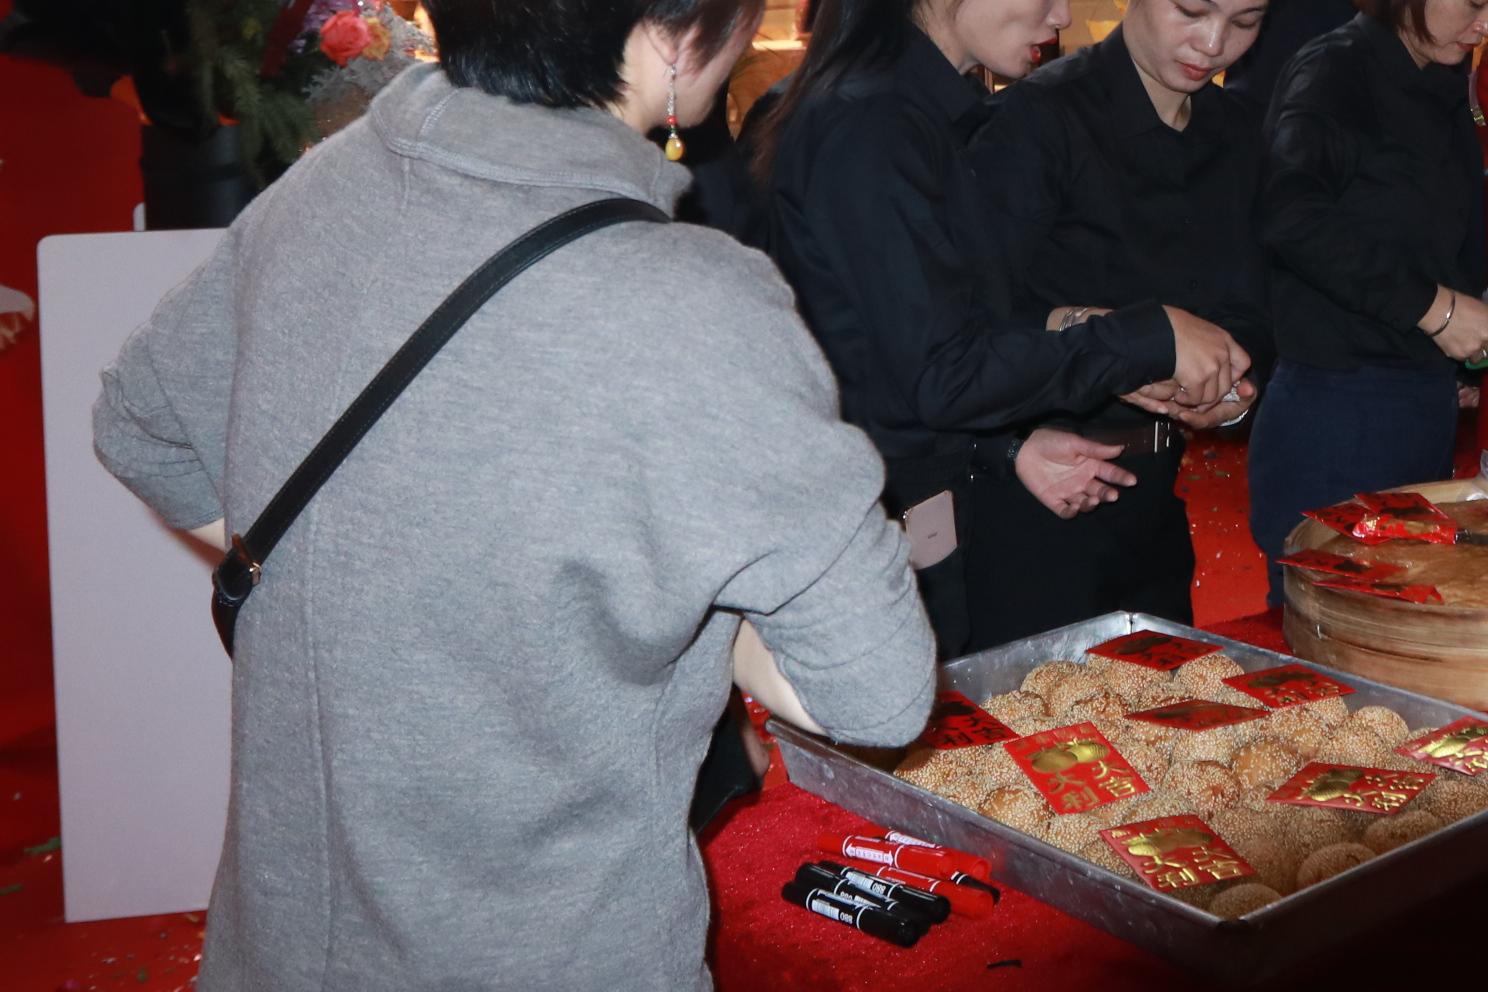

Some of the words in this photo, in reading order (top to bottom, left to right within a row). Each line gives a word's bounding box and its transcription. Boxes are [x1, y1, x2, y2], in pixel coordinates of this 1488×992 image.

[1046, 771, 1100, 810] 大利
[1091, 759, 1137, 799] 大吉
[1143, 855, 1200, 889] 大利
[1192, 845, 1243, 881] 大吉
